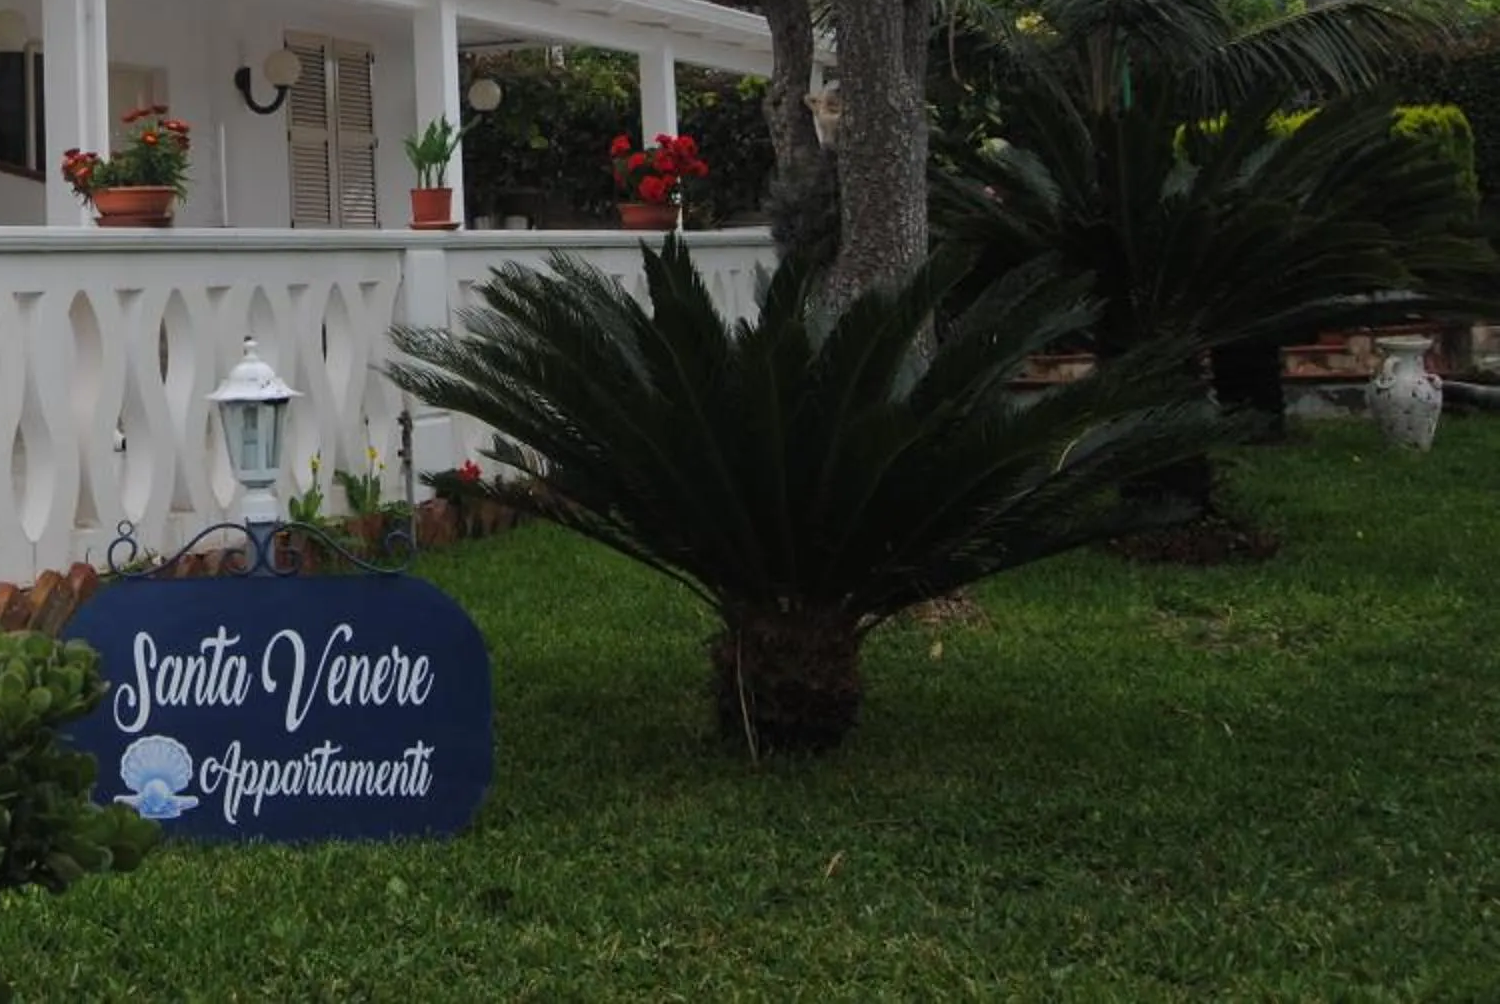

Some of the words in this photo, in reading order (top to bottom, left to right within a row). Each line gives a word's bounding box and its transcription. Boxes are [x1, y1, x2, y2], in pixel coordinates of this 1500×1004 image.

[114, 626, 252, 733] Santa
[261, 623, 435, 733] Venere
[200, 740, 435, 825] Appartamenti
